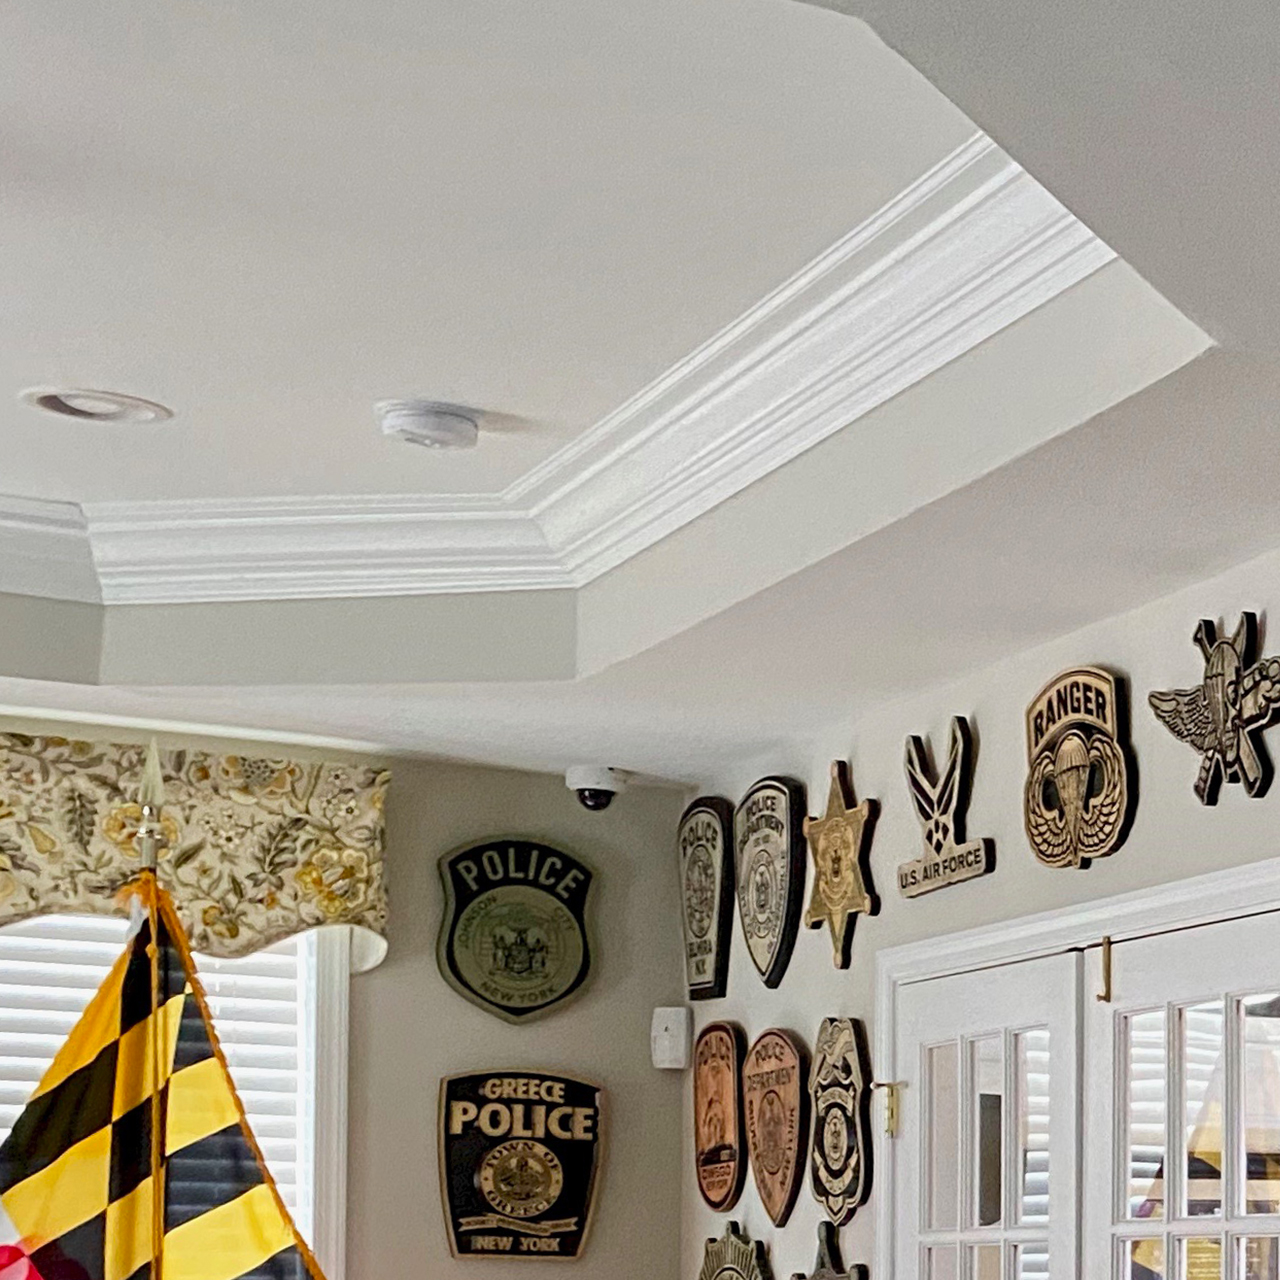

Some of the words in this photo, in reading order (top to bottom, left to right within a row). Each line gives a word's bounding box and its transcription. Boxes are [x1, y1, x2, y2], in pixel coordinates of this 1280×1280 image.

[1033, 681, 1108, 747] RANGER
[746, 796, 777, 820] POLICE
[681, 821, 718, 857] POLICE
[456, 848, 585, 899] POLICE
[900, 870, 920, 889] U.S.
[922, 862, 941, 882] AIR
[942, 848, 983, 875] FORCE
[458, 896, 497, 949] JOHNSON
[554, 906, 577, 931] CITY
[481, 982, 514, 1001] NEW
[520, 985, 556, 1002] YORK
[484, 1078, 566, 1103] GREECE
[449, 1100, 595, 1141] POLICE
[485, 1142, 536, 1171] TOWN
[543, 1151, 560, 1174] OF
[473, 1237, 513, 1250] NEW
[519, 1237, 560, 1251] YORK
